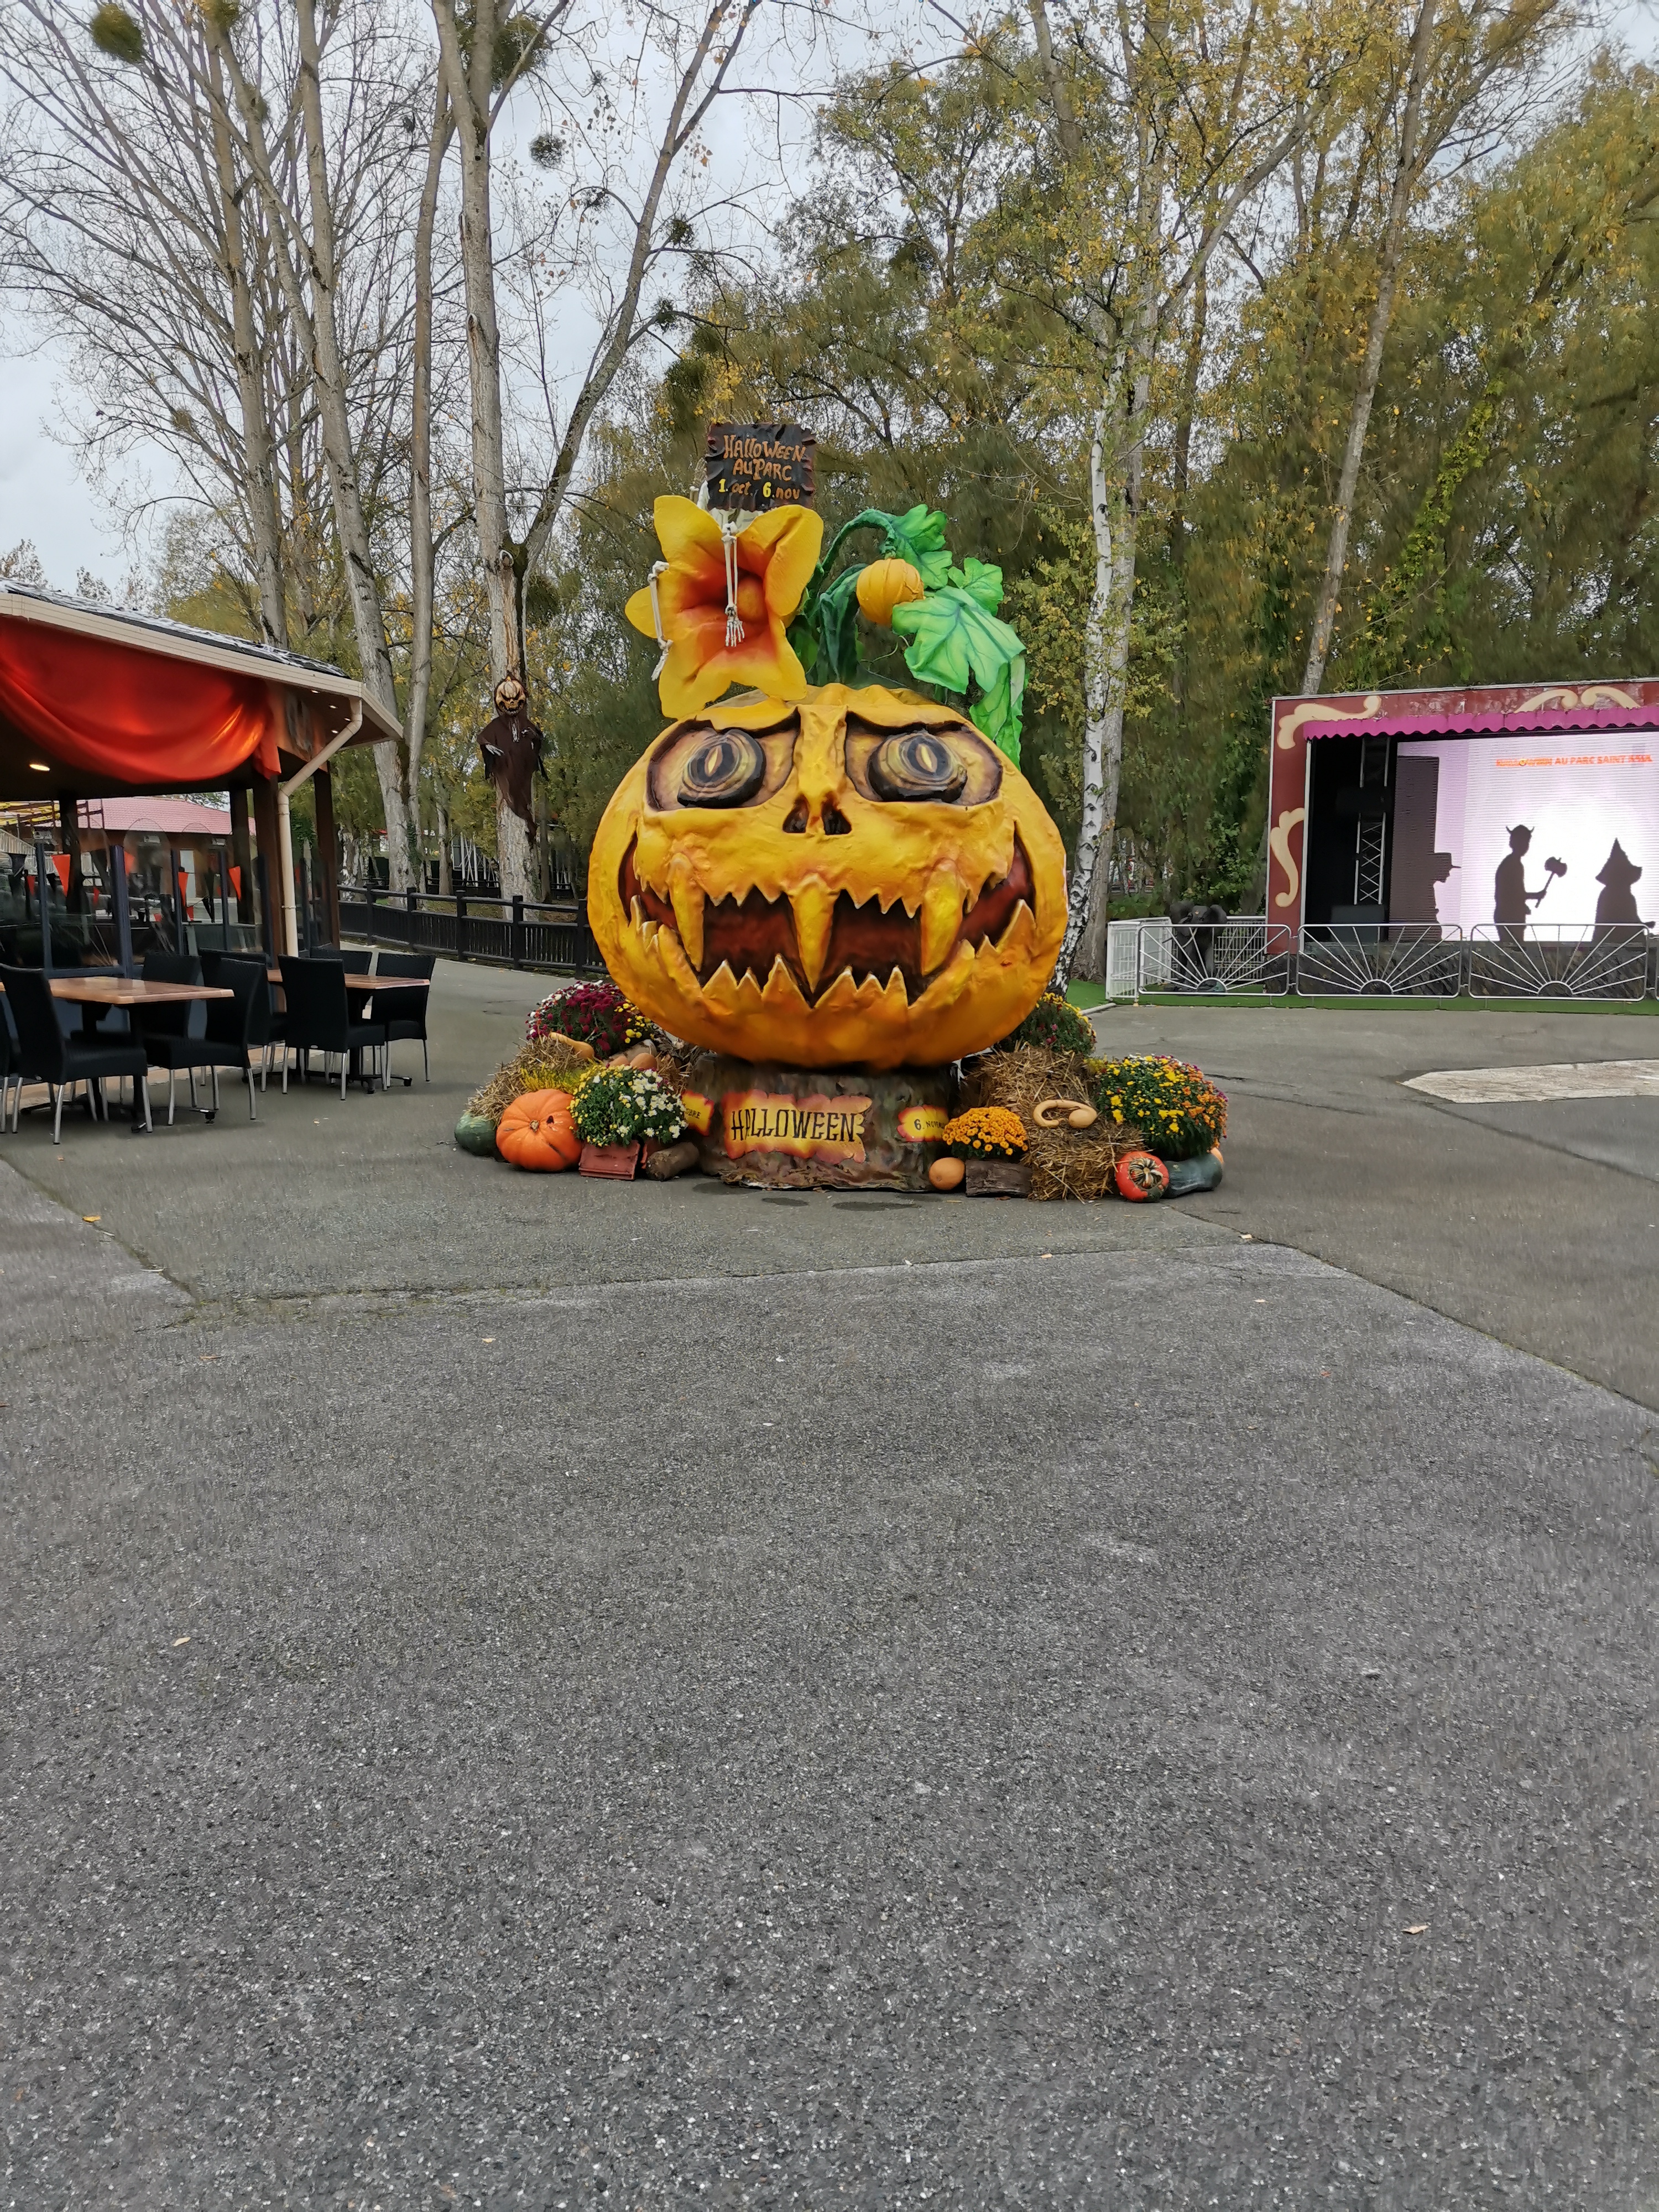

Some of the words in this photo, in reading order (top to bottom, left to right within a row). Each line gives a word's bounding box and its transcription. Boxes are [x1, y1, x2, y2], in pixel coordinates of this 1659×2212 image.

[723, 435, 806, 462] HALLOWEEN
[732, 458, 753, 476] AU
[753, 458, 792, 481] PARC
[1570, 756, 1594, 765] PARC
[731, 1107, 859, 1142] HALLOWEEN
